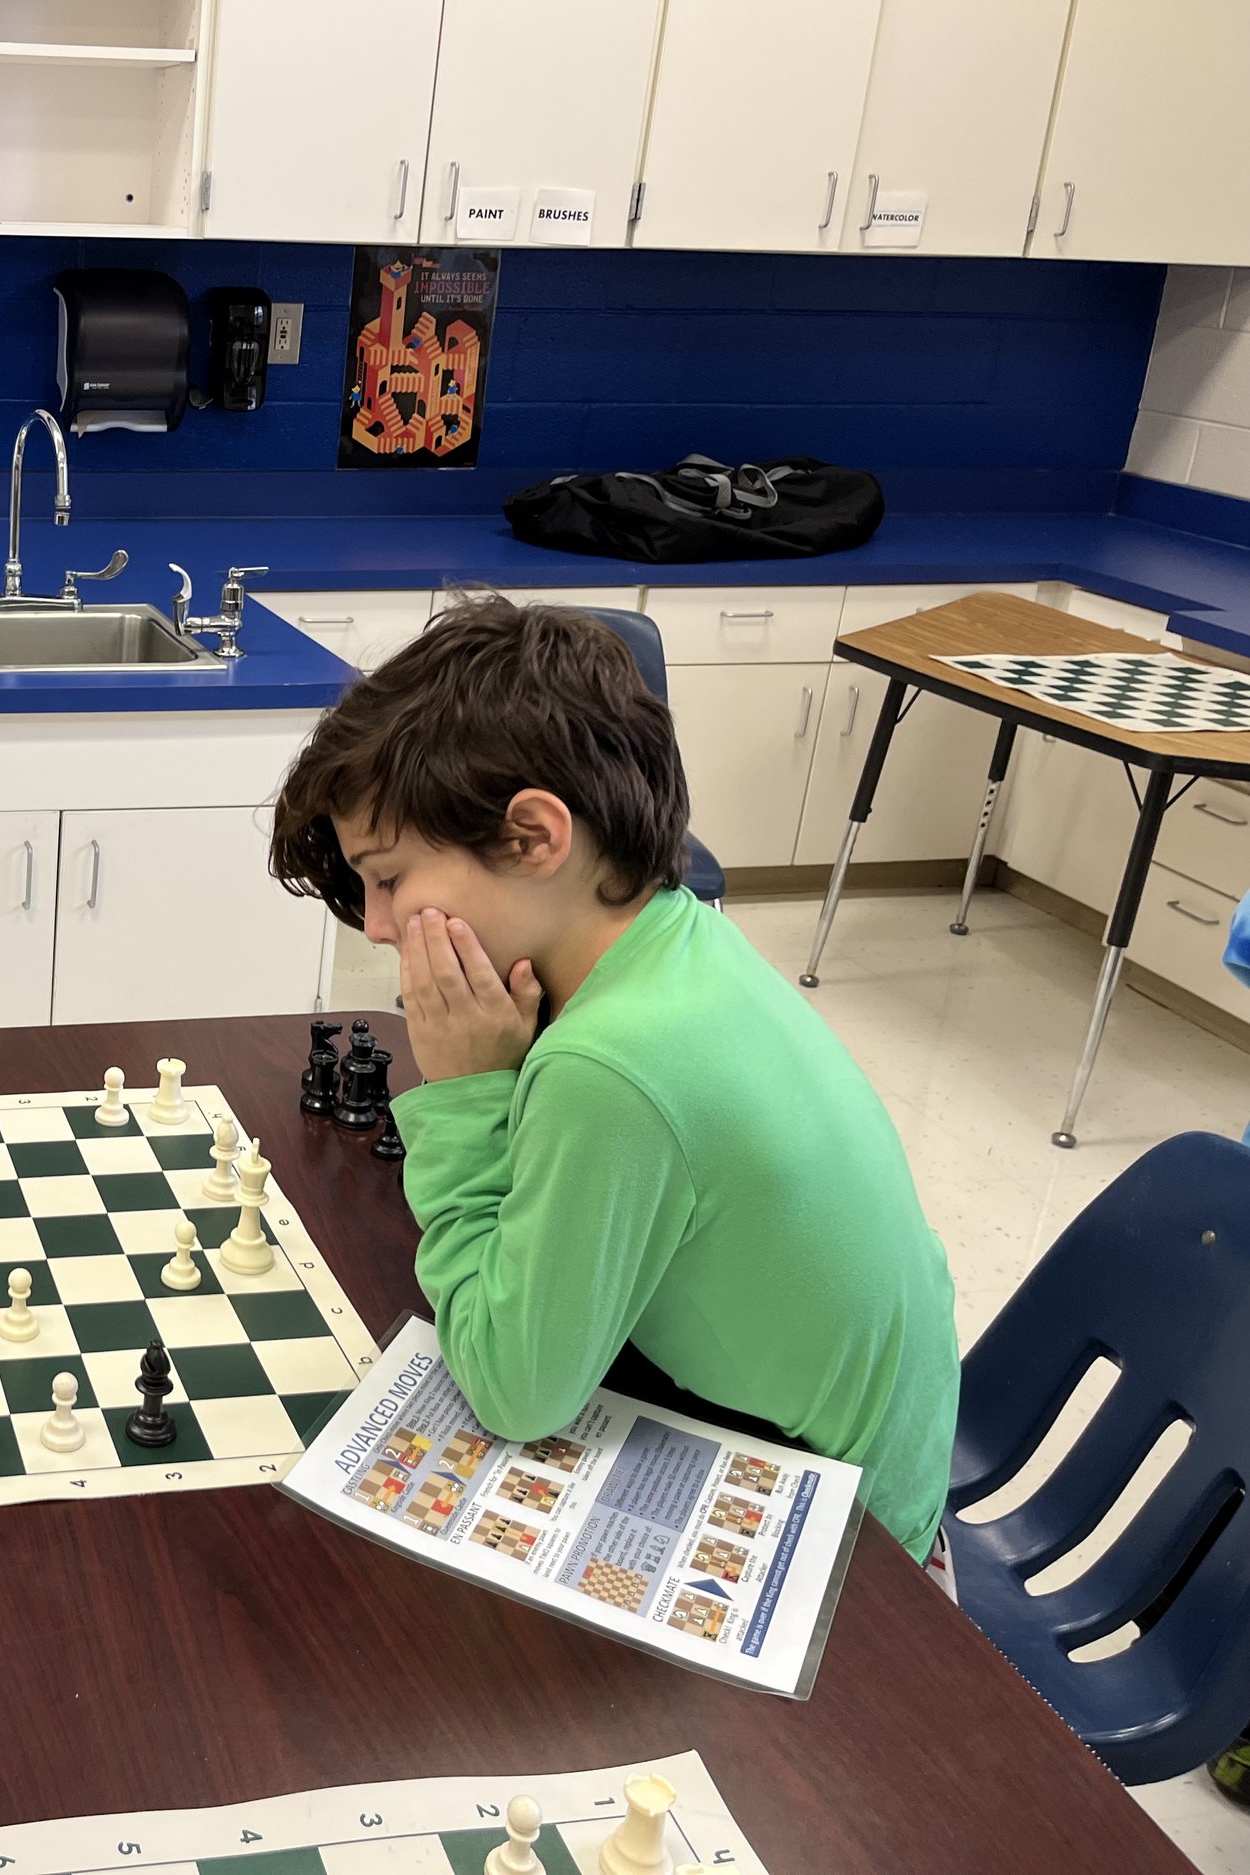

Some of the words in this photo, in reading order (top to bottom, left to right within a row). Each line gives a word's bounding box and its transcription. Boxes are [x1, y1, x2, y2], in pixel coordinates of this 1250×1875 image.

[468, 208, 504, 220] PAINT
[538, 209, 590, 222] BRUSHES
[421, 272, 429, 280] IT
[431, 272, 460, 280] ALWAYS
[462, 272, 486, 280] SEEMS
[414, 282, 490, 294] IMPOSSIBLE
[421, 295, 444, 303] UNTIL
[446, 295, 462, 303] IT'S
[464, 295, 483, 303] DONE
[359, 1356, 373, 1365] b
[330, 1397, 401, 1474] ADVANCED
[386, 1352, 435, 1400] MOVES
[384, 1447, 401, 1458] 2
[259, 1463, 277, 1473] 2
[438, 1458, 454, 1469] 2
[165, 1472, 183, 1480] 3
[341, 1462, 370, 1495] CASTLING
[70, 1480, 87, 1488] 4
[353, 1491, 370, 1501] 1
[401, 1514, 418, 1525] 1
[450, 1532, 463, 1544] EN
[457, 1501, 481, 1533] PASSANT
[558, 1560, 577, 1584] PAWN
[570, 1515, 600, 1560] PROMOTION
[652, 1576, 679, 1623] CHECKMATE
[726, 1612, 737, 1624] King
[593, 1797, 616, 1808] 1
[475, 1803, 500, 1819] 2
[359, 1812, 383, 1828] 3
[240, 1829, 263, 1843] 4
[118, 1841, 142, 1855] 5
[712, 1848, 736, 1865] h
